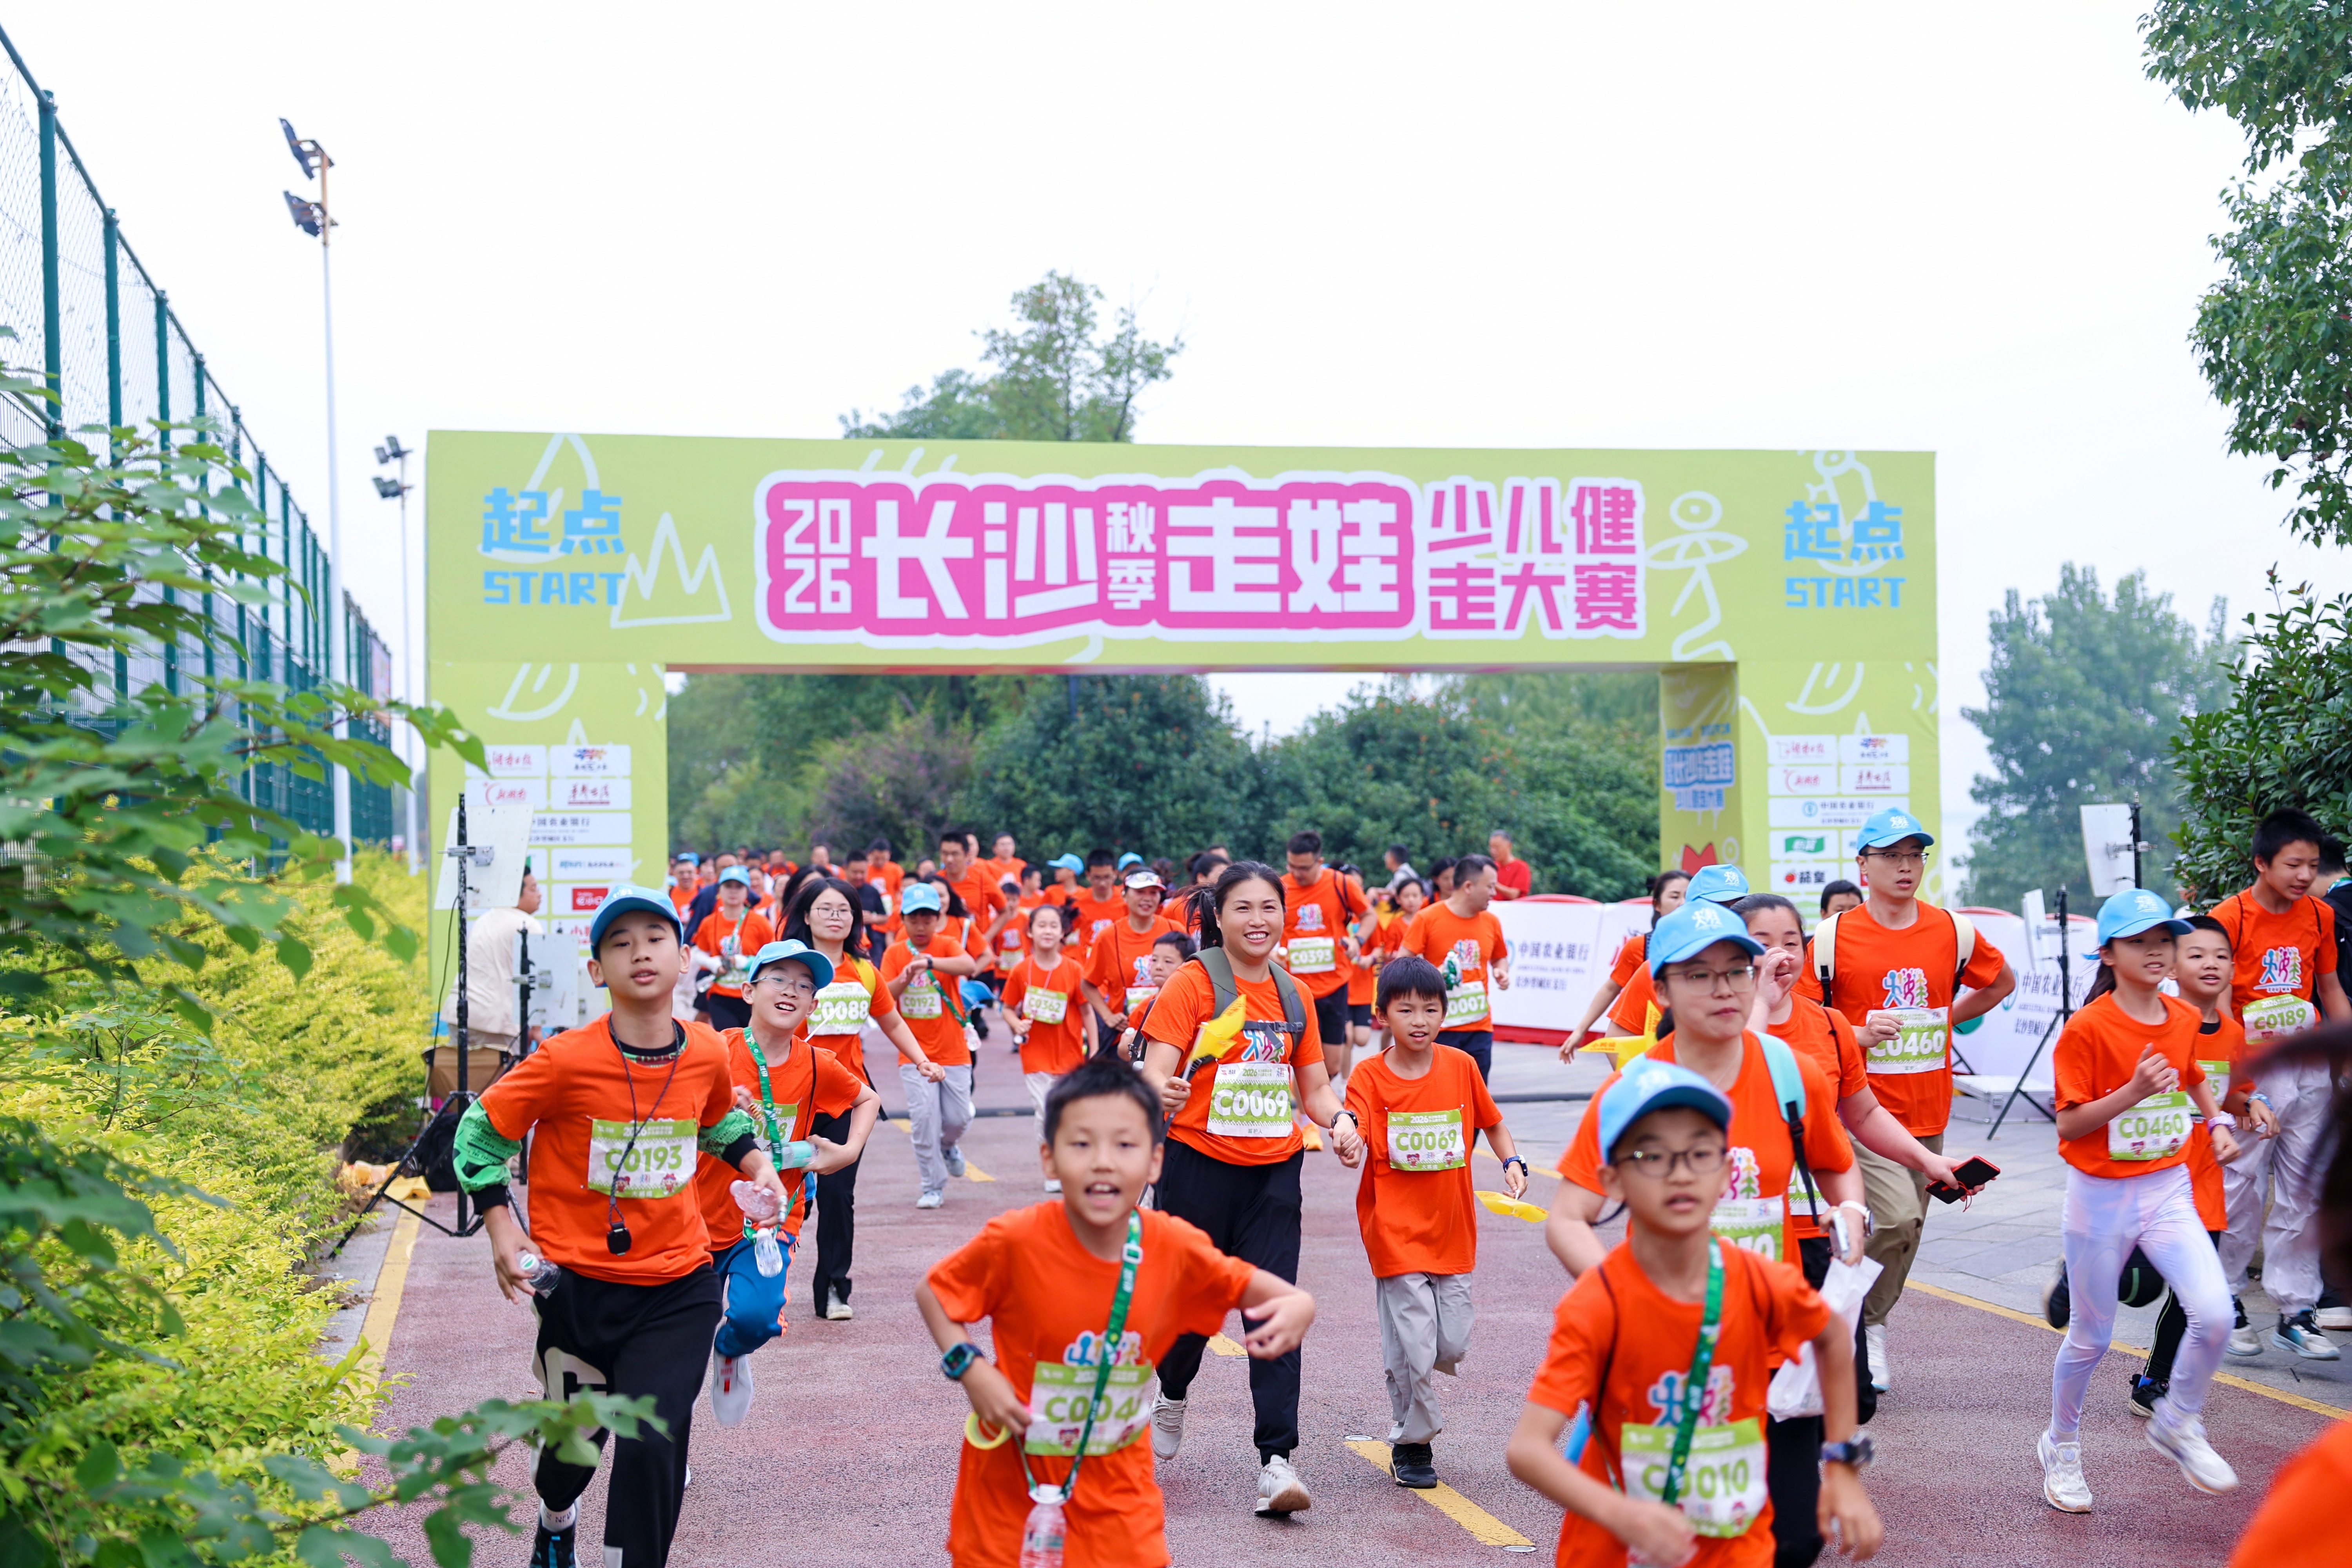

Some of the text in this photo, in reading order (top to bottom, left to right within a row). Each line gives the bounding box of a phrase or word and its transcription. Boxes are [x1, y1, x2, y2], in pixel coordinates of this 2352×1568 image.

[481, 487, 624, 555] 起点
[1428, 485, 1636, 554] 少儿健
[1784, 501, 1905, 561] 起点
[862, 497, 1398, 619] 长沙 秋季 走娃
[483, 571, 626, 606] START
[1428, 563, 1637, 630] 走大赛
[1785, 577, 1906, 608] START
[1820, 801, 1874, 809] 中国农业银行
[1290, 948, 1333, 965] C0393
[1518, 941, 1589, 960] 中国农业银行
[2022, 971, 2083, 998] 中国农业行
[904, 997, 935, 1007] C0192
[1029, 998, 1061, 1013] C0362
[1446, 995, 1485, 1016] 0007
[2254, 1007, 2307, 1030] C0189
[1242, 1069, 1258, 1077] 2026
[1214, 1089, 1288, 1117] C0069
[2120, 1113, 2183, 1138] C0460
[1396, 1129, 1457, 1151] C0069
[605, 1145, 682, 1172] C0193
